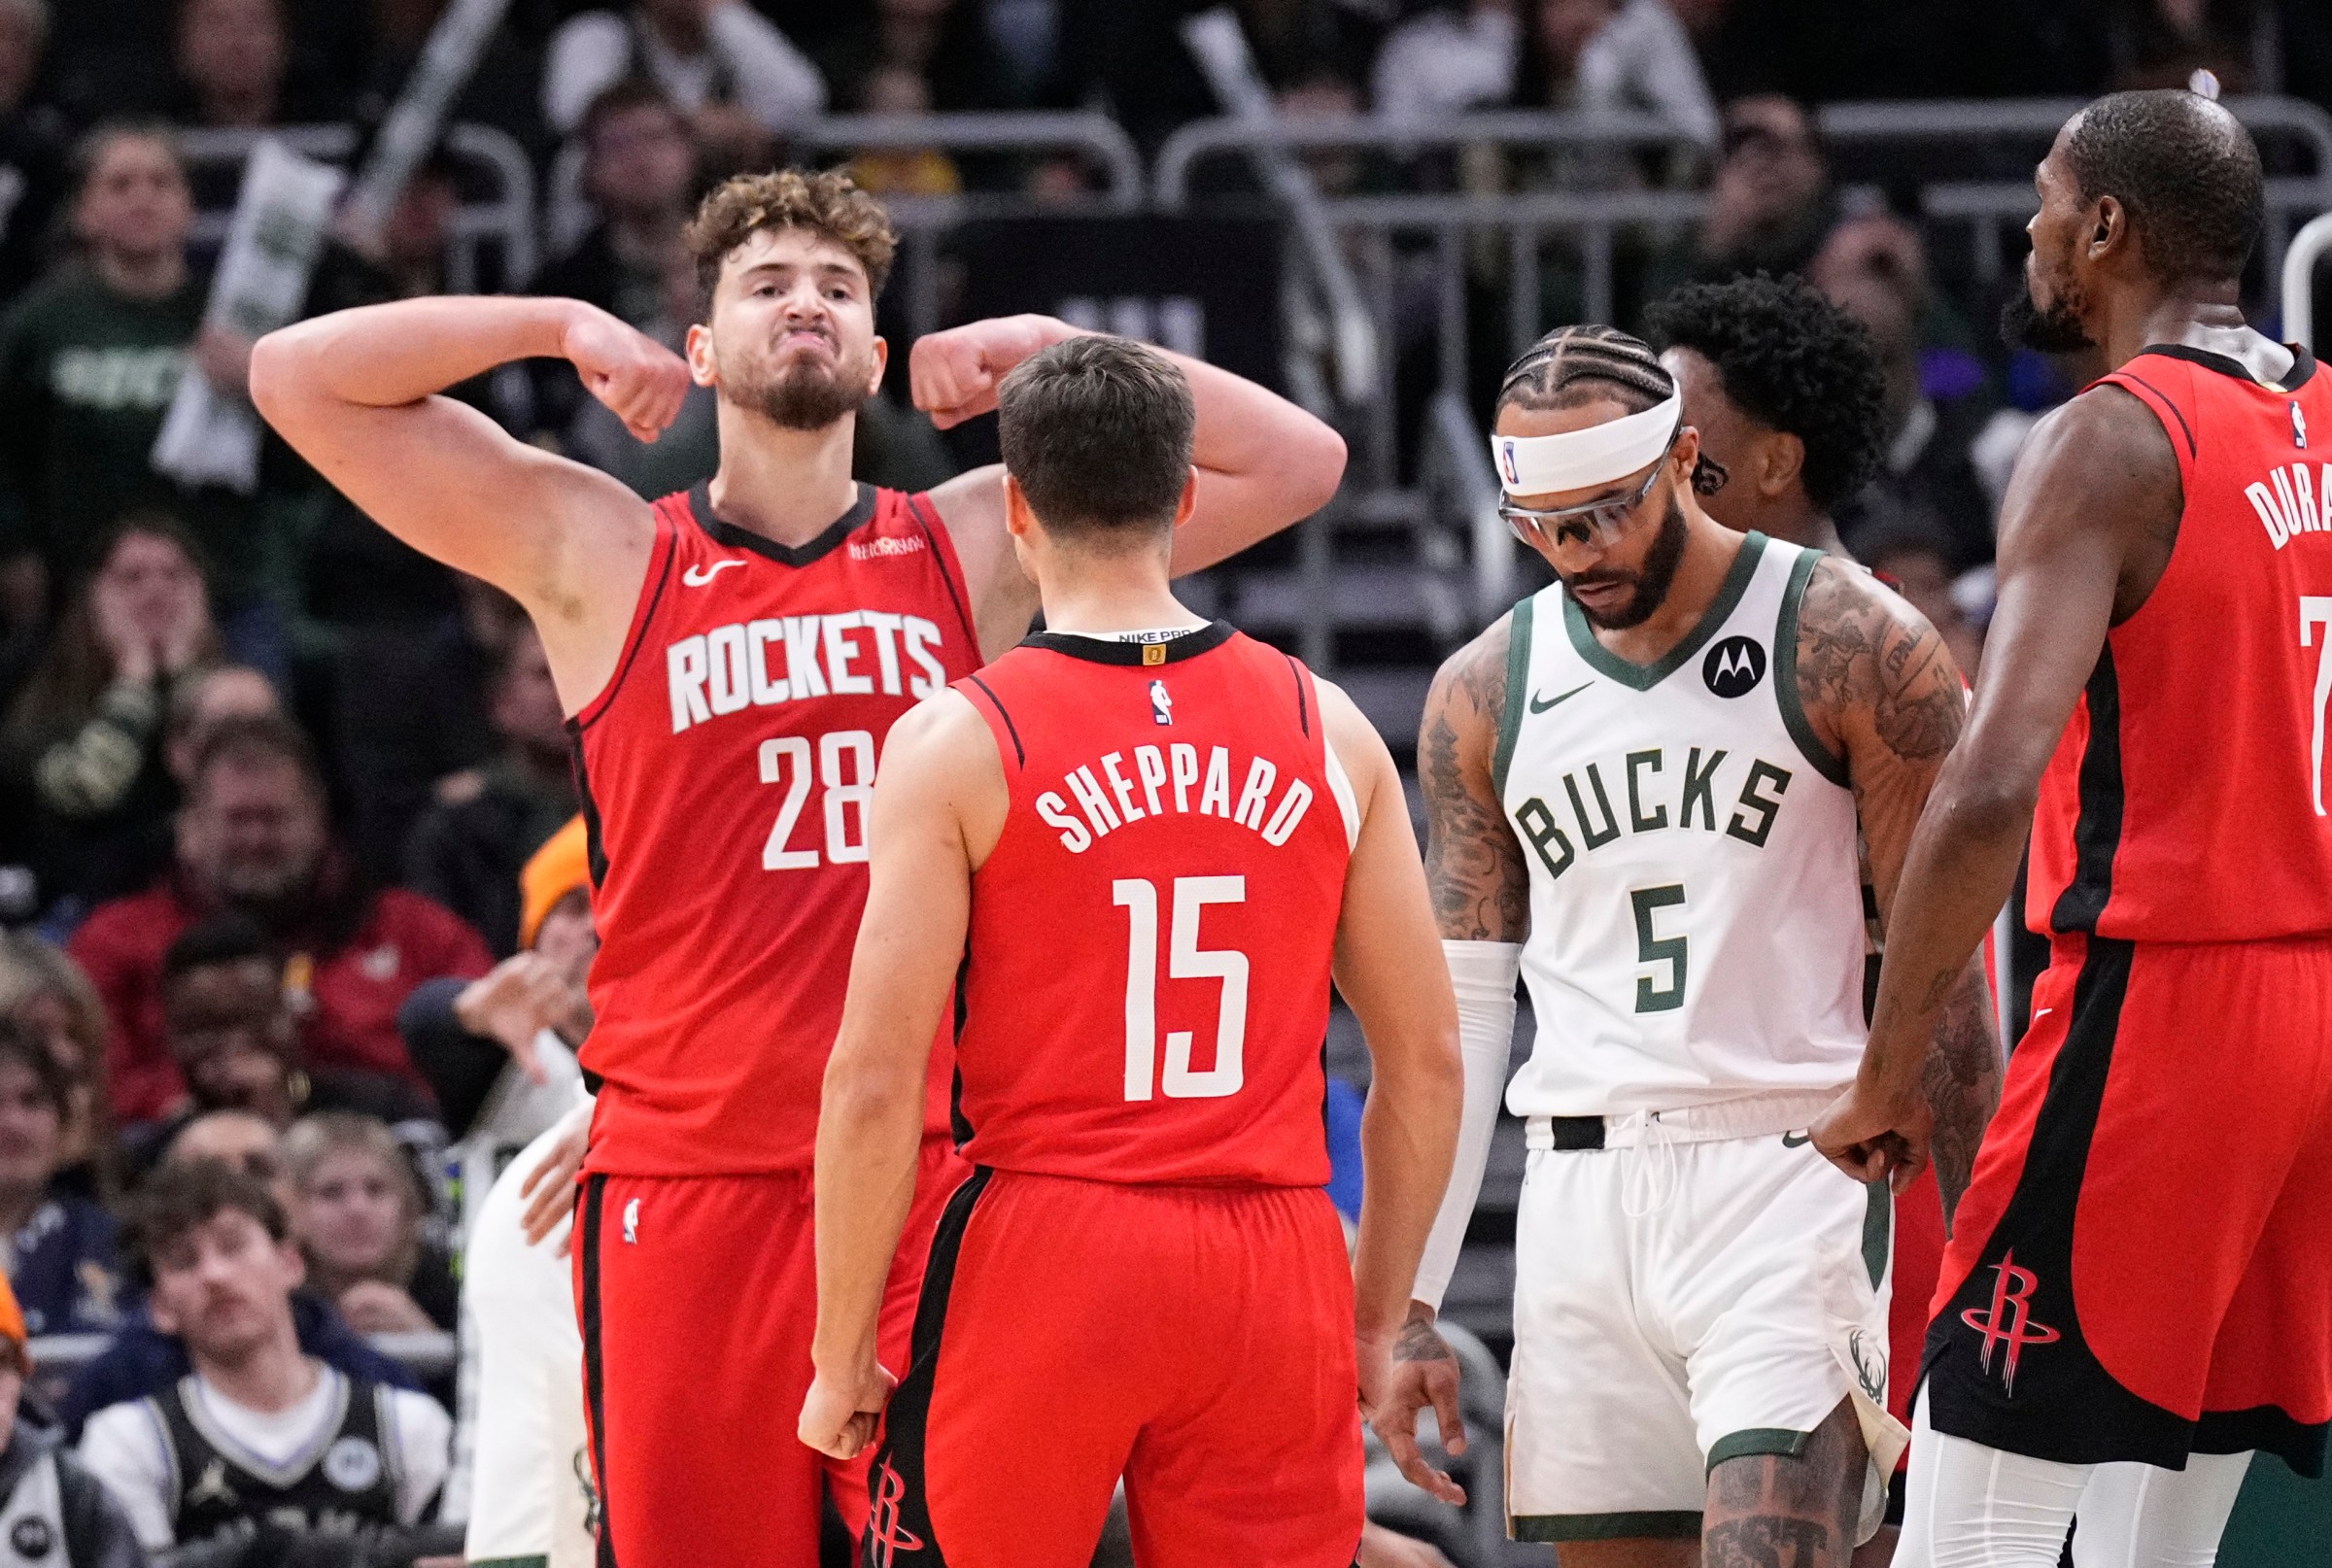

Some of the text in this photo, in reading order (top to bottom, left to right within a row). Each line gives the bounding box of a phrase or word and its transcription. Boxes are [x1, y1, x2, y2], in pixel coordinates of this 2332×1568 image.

[668, 609, 945, 734] ROCKETS
[1119, 631, 1156, 643] NIKE
[2299, 596, 2332, 817] 7
[759, 730, 875, 870] 28
[1036, 743, 1314, 853] SHEPPARD
[1515, 747, 1793, 880] BUCKS
[1112, 875, 1250, 1102] 15
[1630, 884, 1688, 1013] 5
